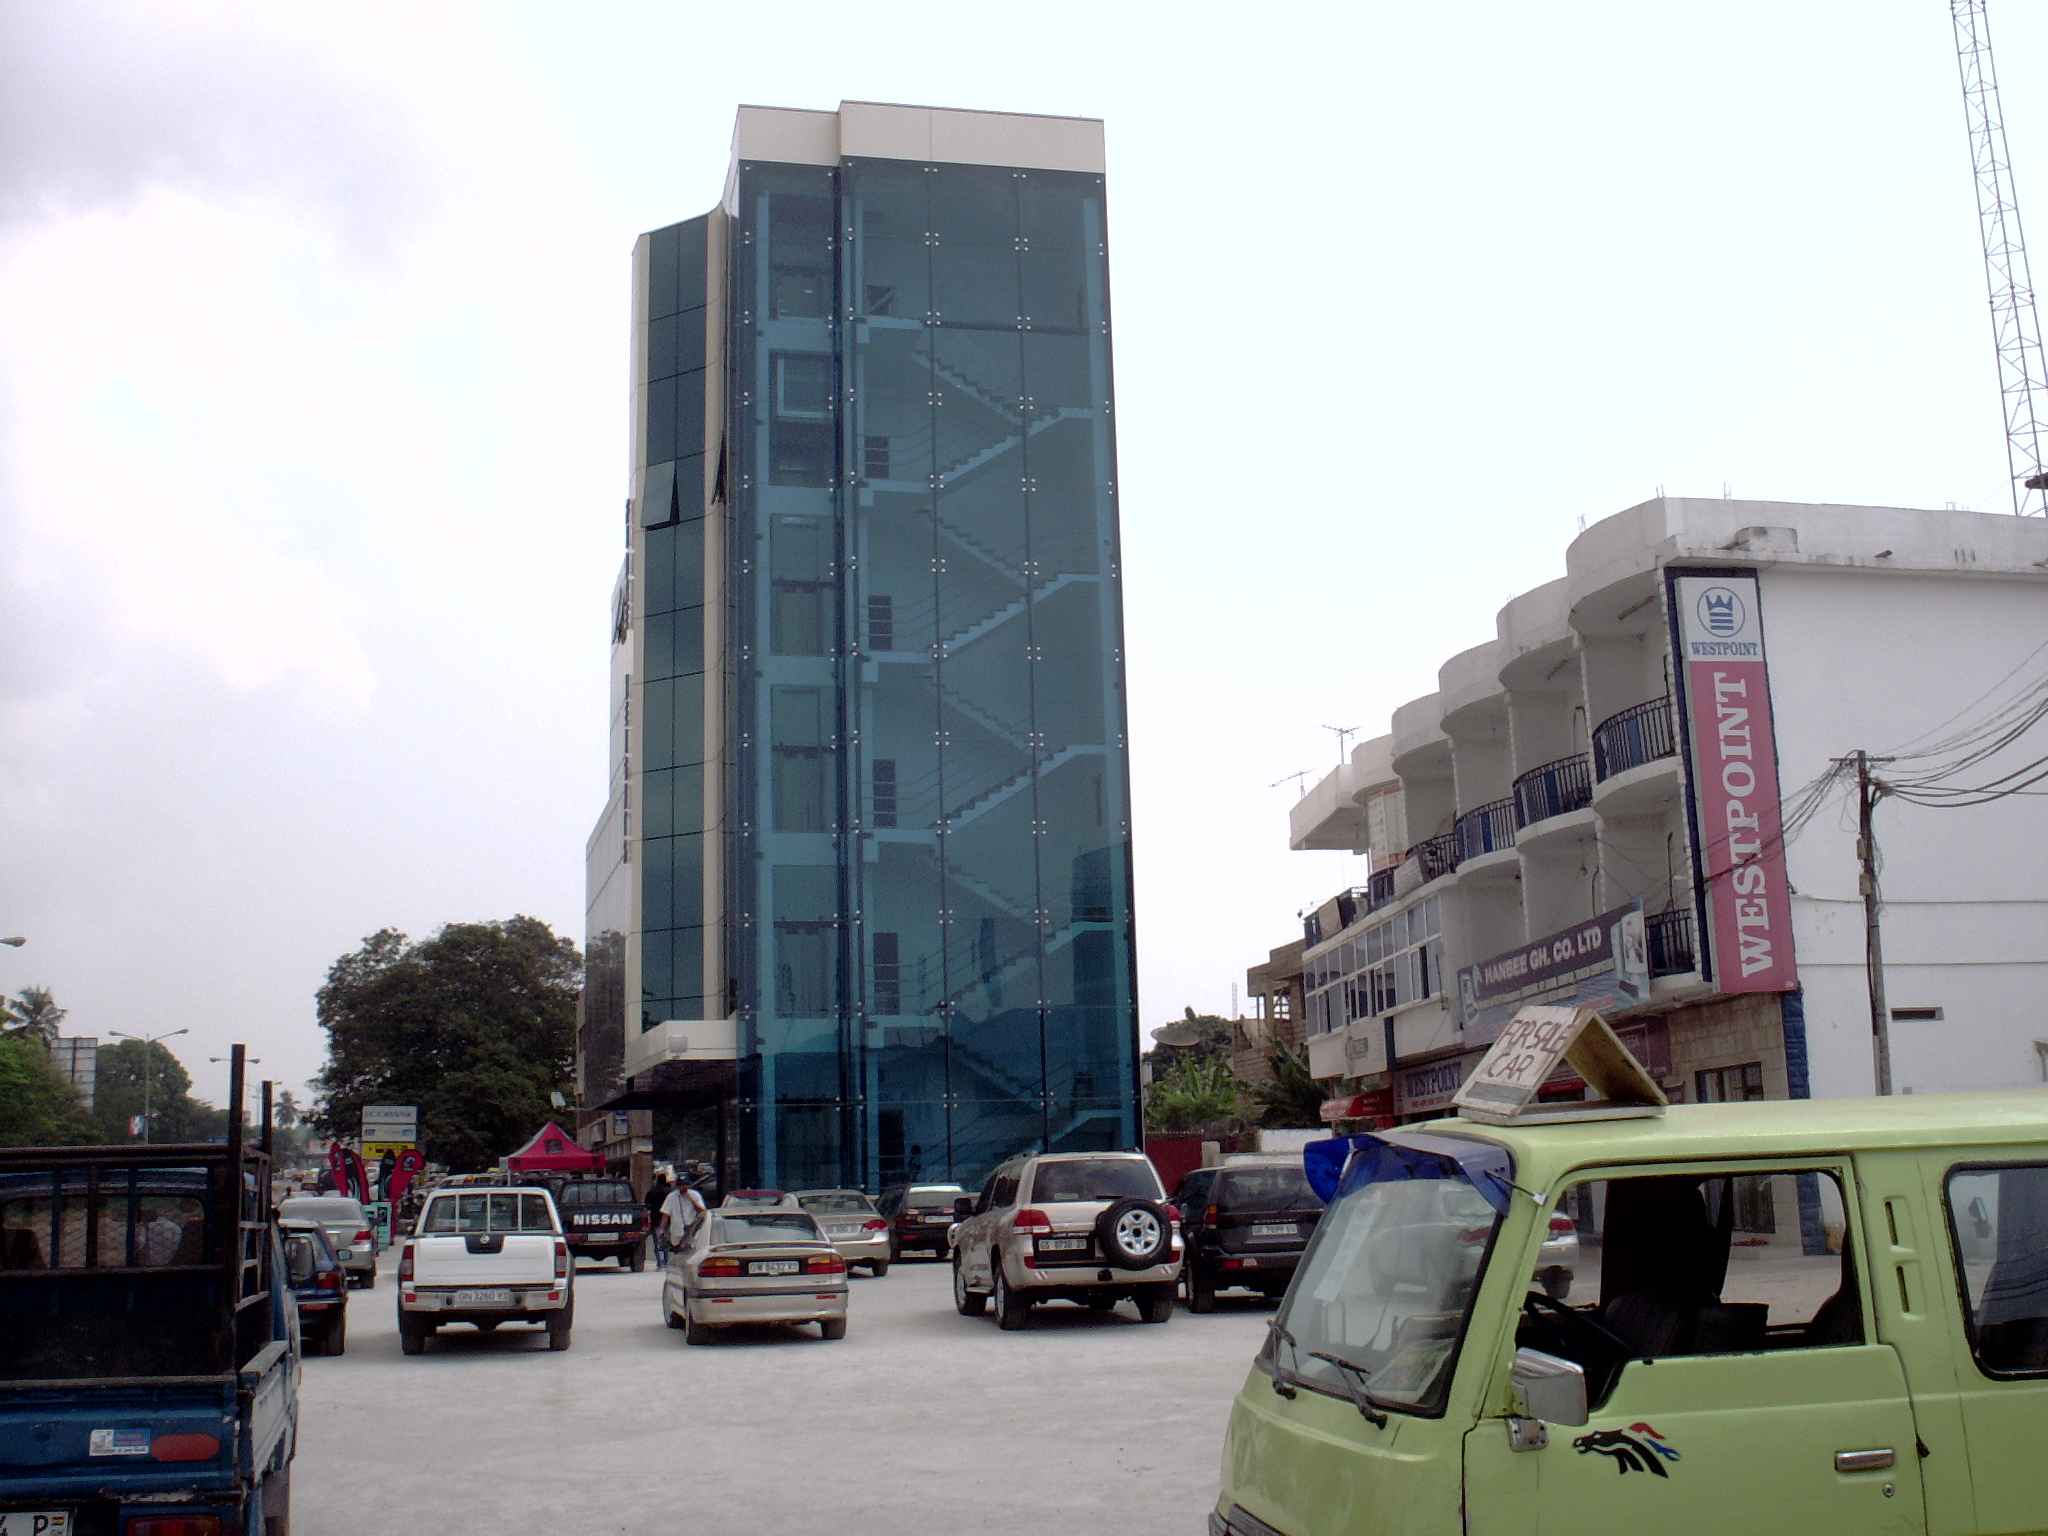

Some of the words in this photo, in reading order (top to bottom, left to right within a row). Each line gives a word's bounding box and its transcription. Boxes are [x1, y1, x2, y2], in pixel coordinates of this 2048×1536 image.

[1691, 641, 1758, 656] WESTPOINT
[1714, 672, 1774, 978] WESTPOINT
[1577, 926, 1601, 954] LTD
[1487, 1052, 1535, 1080] CAR
[573, 1213, 633, 1225] NISSAN
